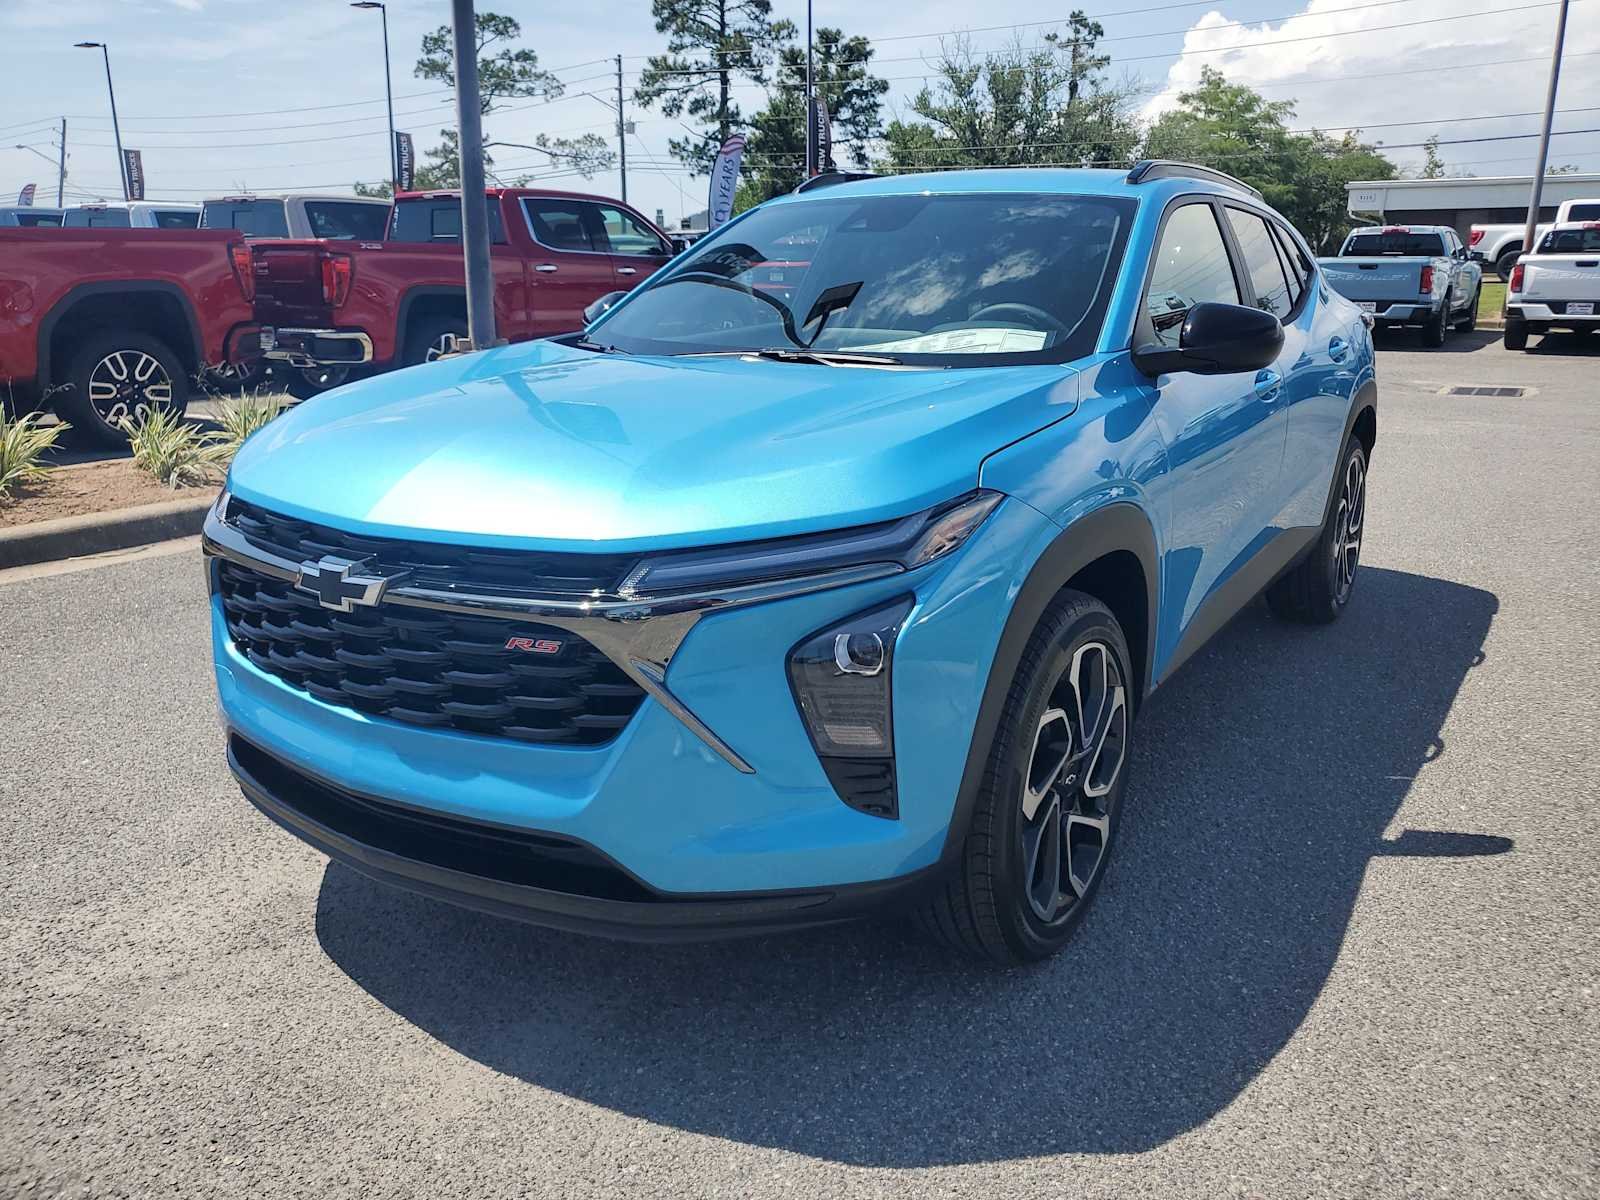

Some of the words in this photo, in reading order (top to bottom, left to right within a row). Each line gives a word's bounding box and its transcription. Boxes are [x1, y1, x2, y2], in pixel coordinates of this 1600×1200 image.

[816, 103, 826, 146] TRUCKS
[399, 135, 409, 168] TRUCKS
[817, 148, 826, 173] NEW
[128, 152, 139, 181] TRUCKS
[401, 170, 410, 190] NEW
[719, 158, 735, 201] YEARS
[132, 182, 140, 199] NEW
[505, 637, 562, 653] RS
